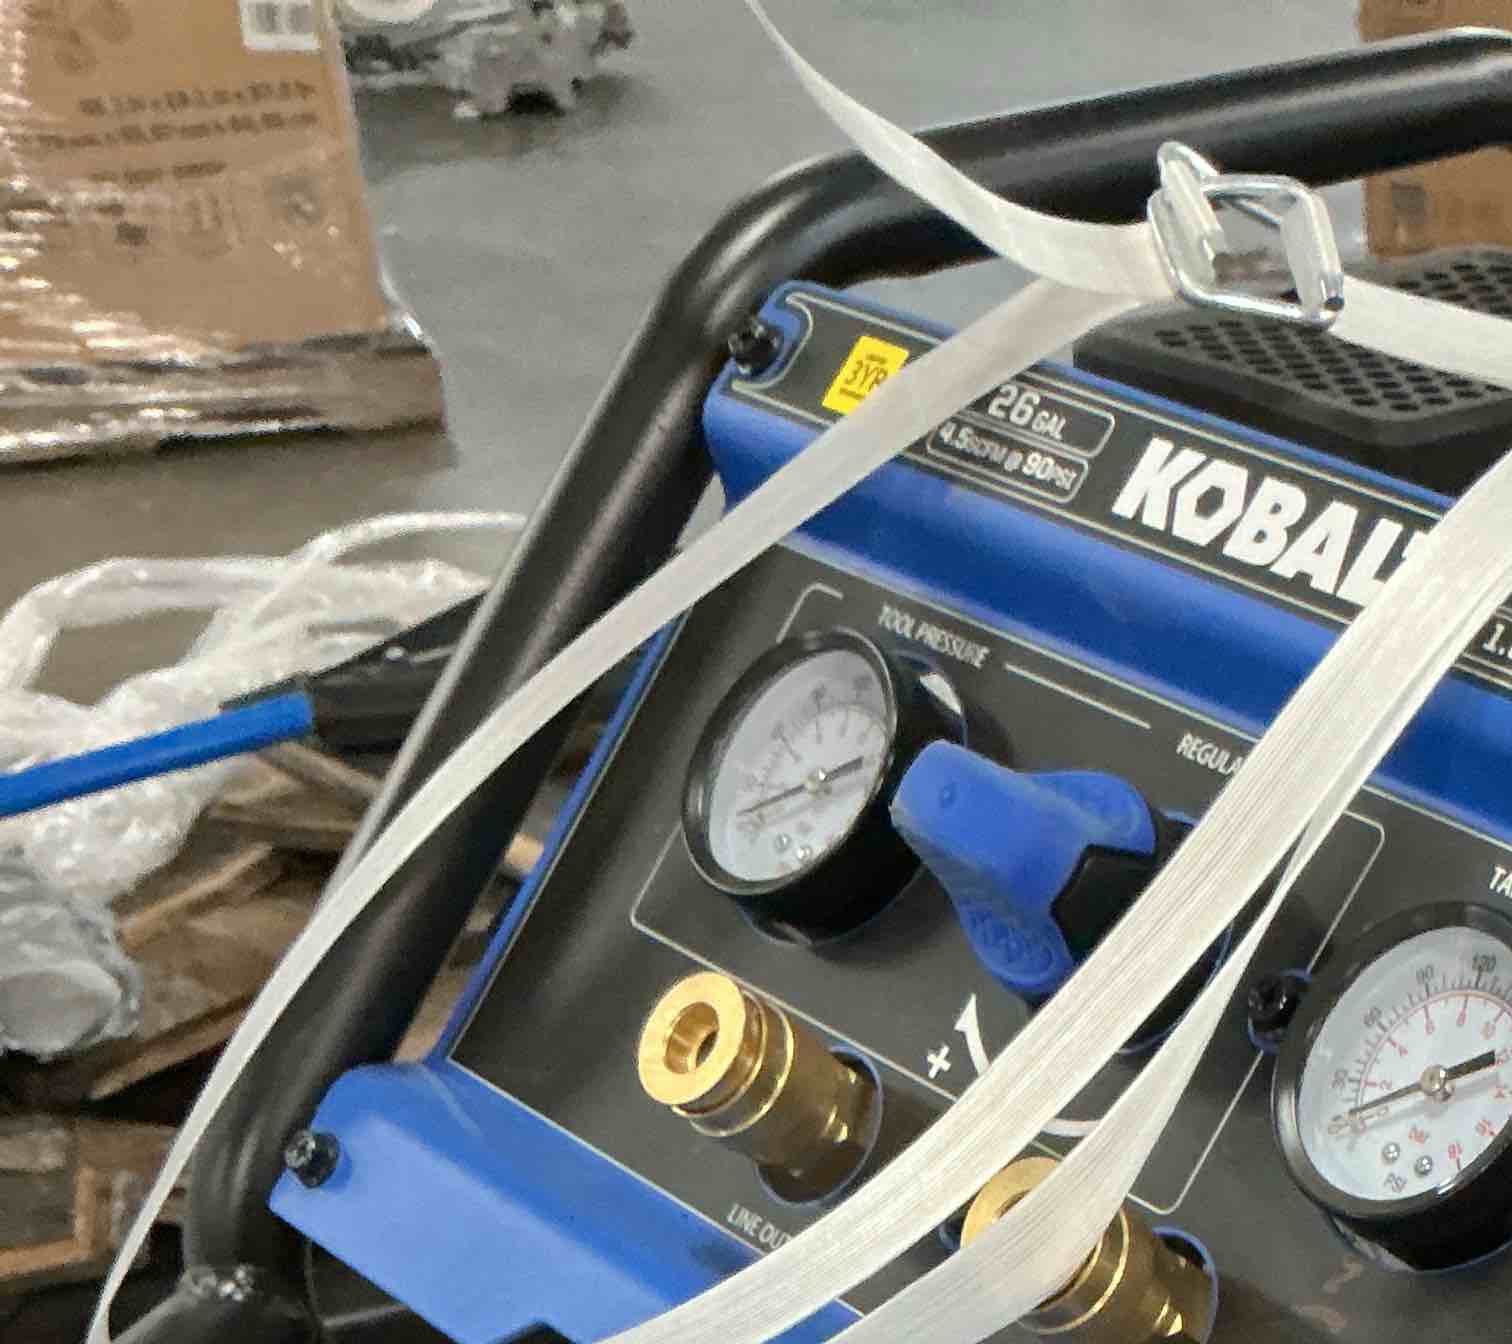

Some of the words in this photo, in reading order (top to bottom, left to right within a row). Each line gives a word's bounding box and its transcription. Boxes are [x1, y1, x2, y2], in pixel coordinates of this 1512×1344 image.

[1111, 437, 1430, 607] KOBAL
[914, 621, 990, 670] PRESSURE
[1176, 733, 1245, 775] REGULA
[727, 1203, 763, 1237] LINE
[758, 1221, 793, 1249] OU
